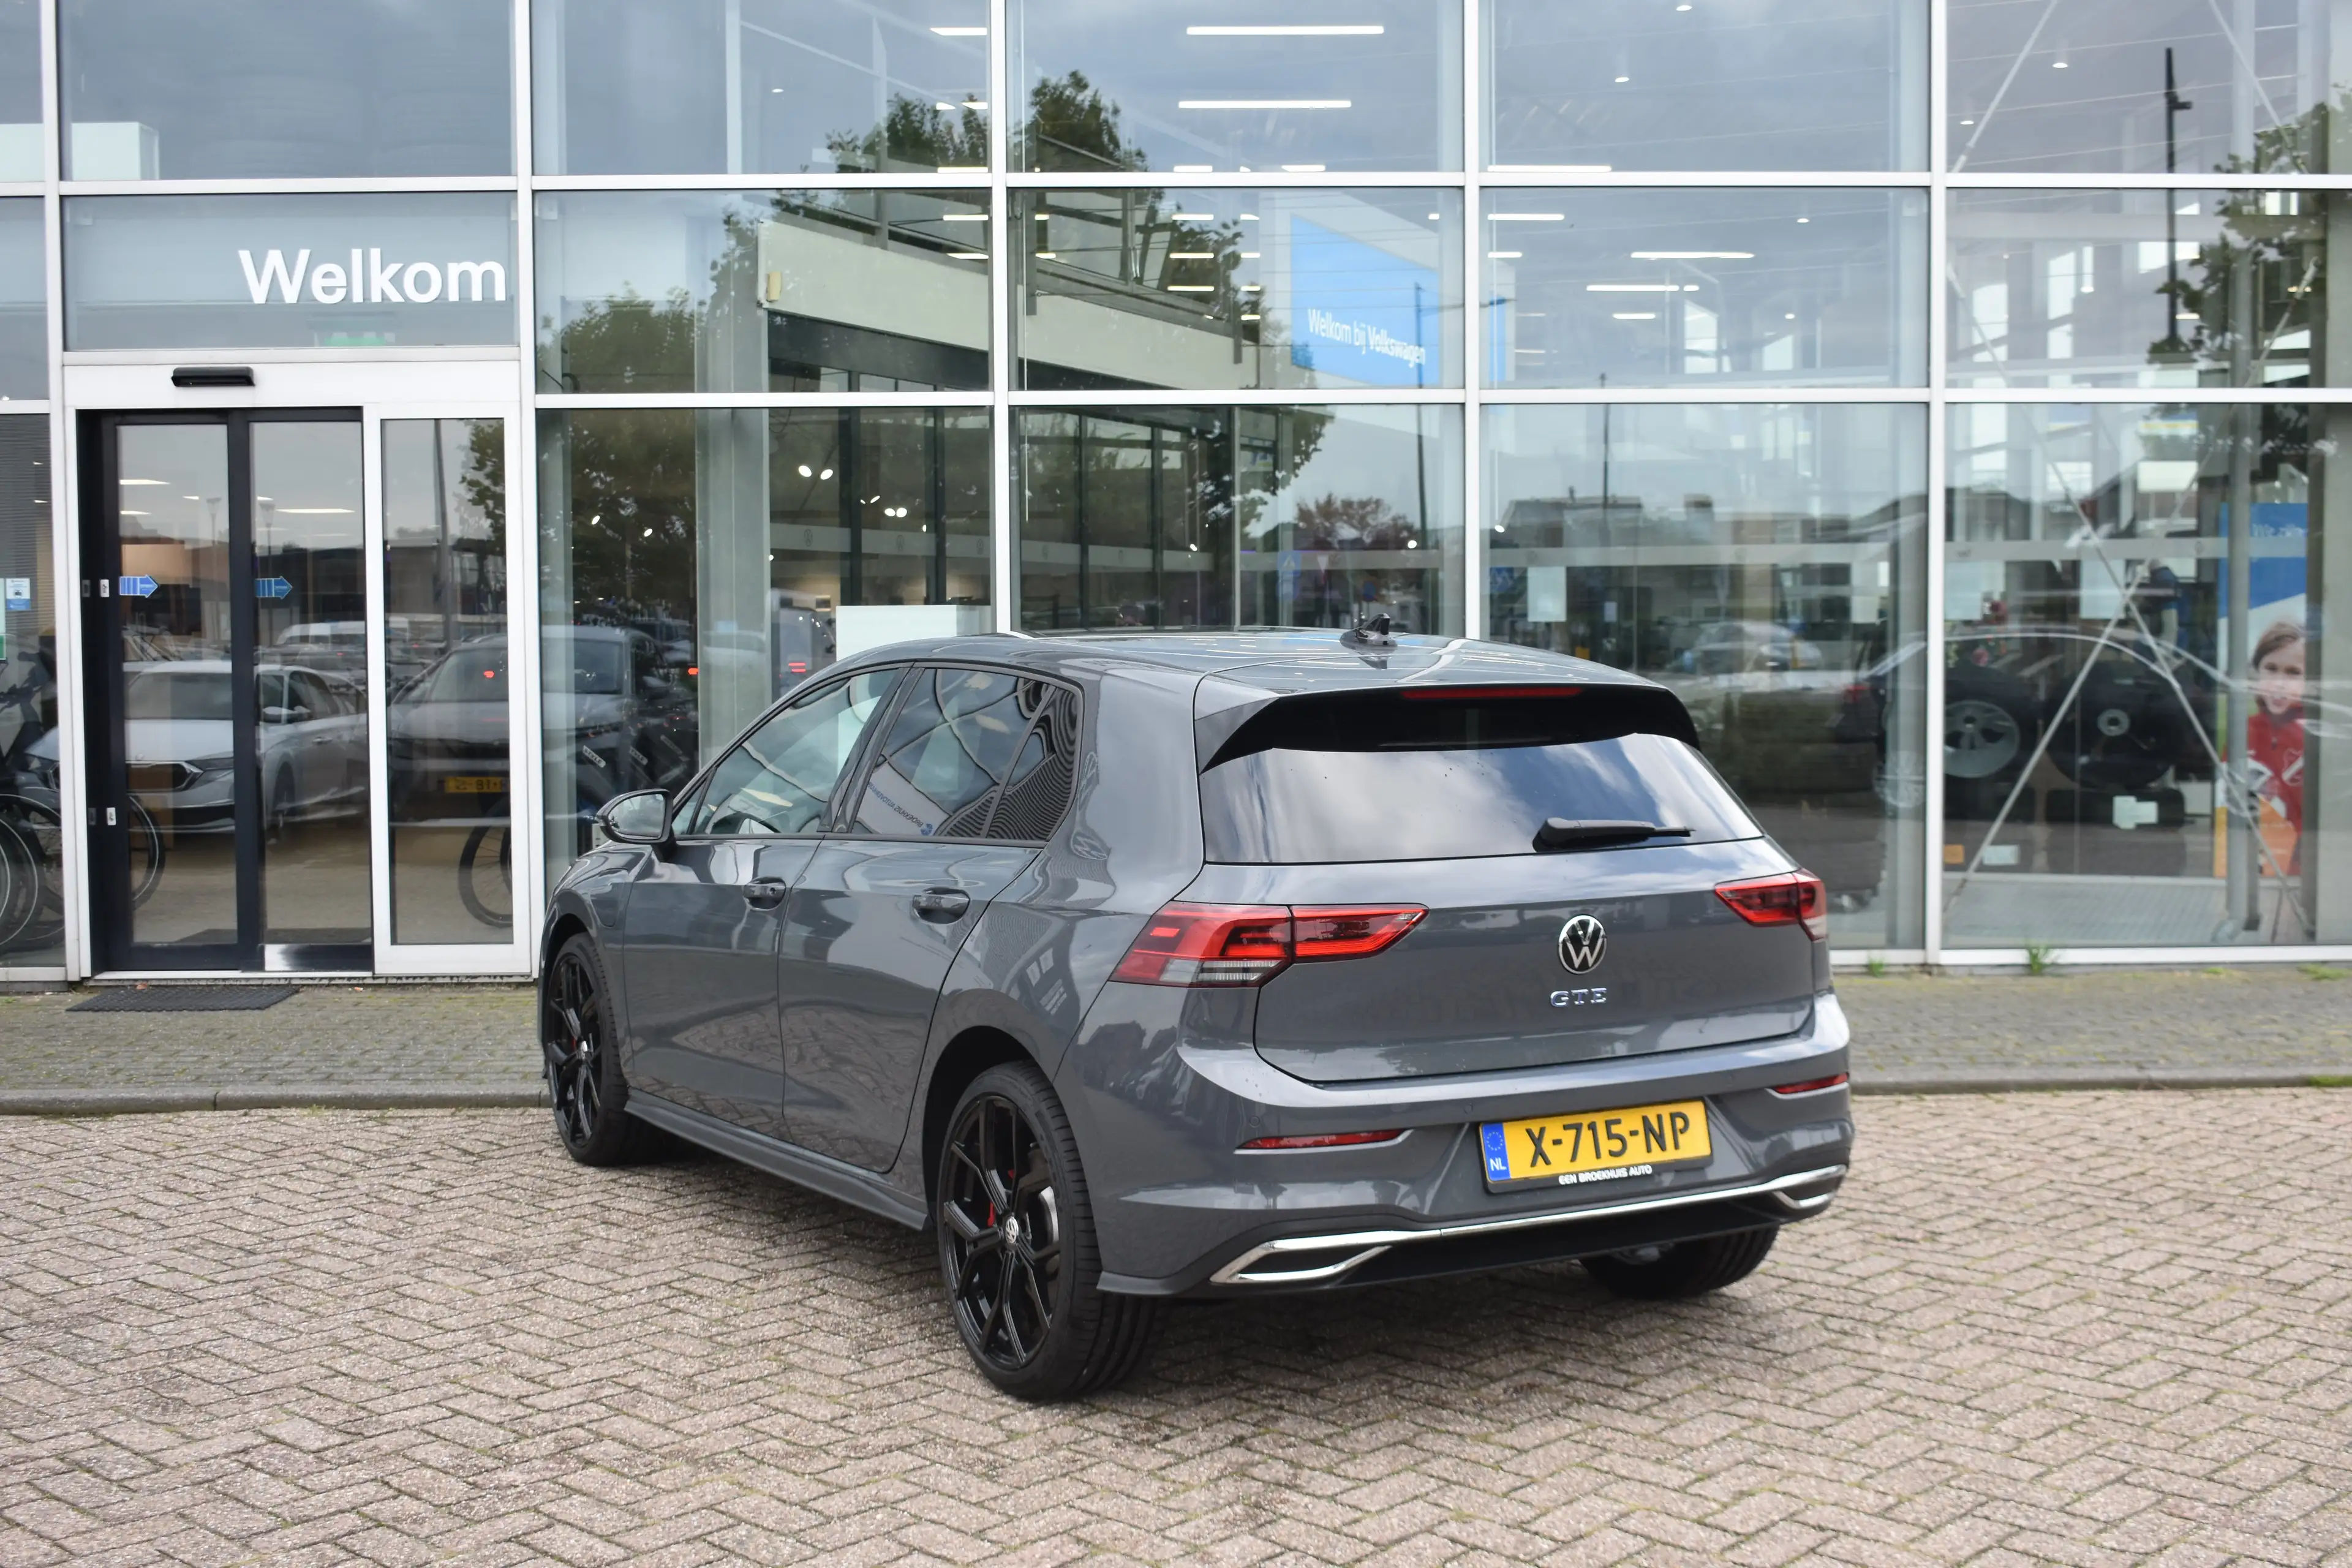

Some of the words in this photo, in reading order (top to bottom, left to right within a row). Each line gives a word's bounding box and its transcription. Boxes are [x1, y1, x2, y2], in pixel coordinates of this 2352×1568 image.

[238, 247, 506, 304] Welkom
[1308, 308, 1352, 344] Welkom
[1353, 320, 1366, 355] bij
[1368, 325, 1426, 368] Volkswagen
[1550, 987, 1607, 1007] GTE
[1525, 1112, 1689, 1167] X-715-NP
[1490, 1157, 1507, 1172] NL
[1578, 1167, 1629, 1183] BROEKHUIS
[1629, 1164, 1653, 1177] AUTO
